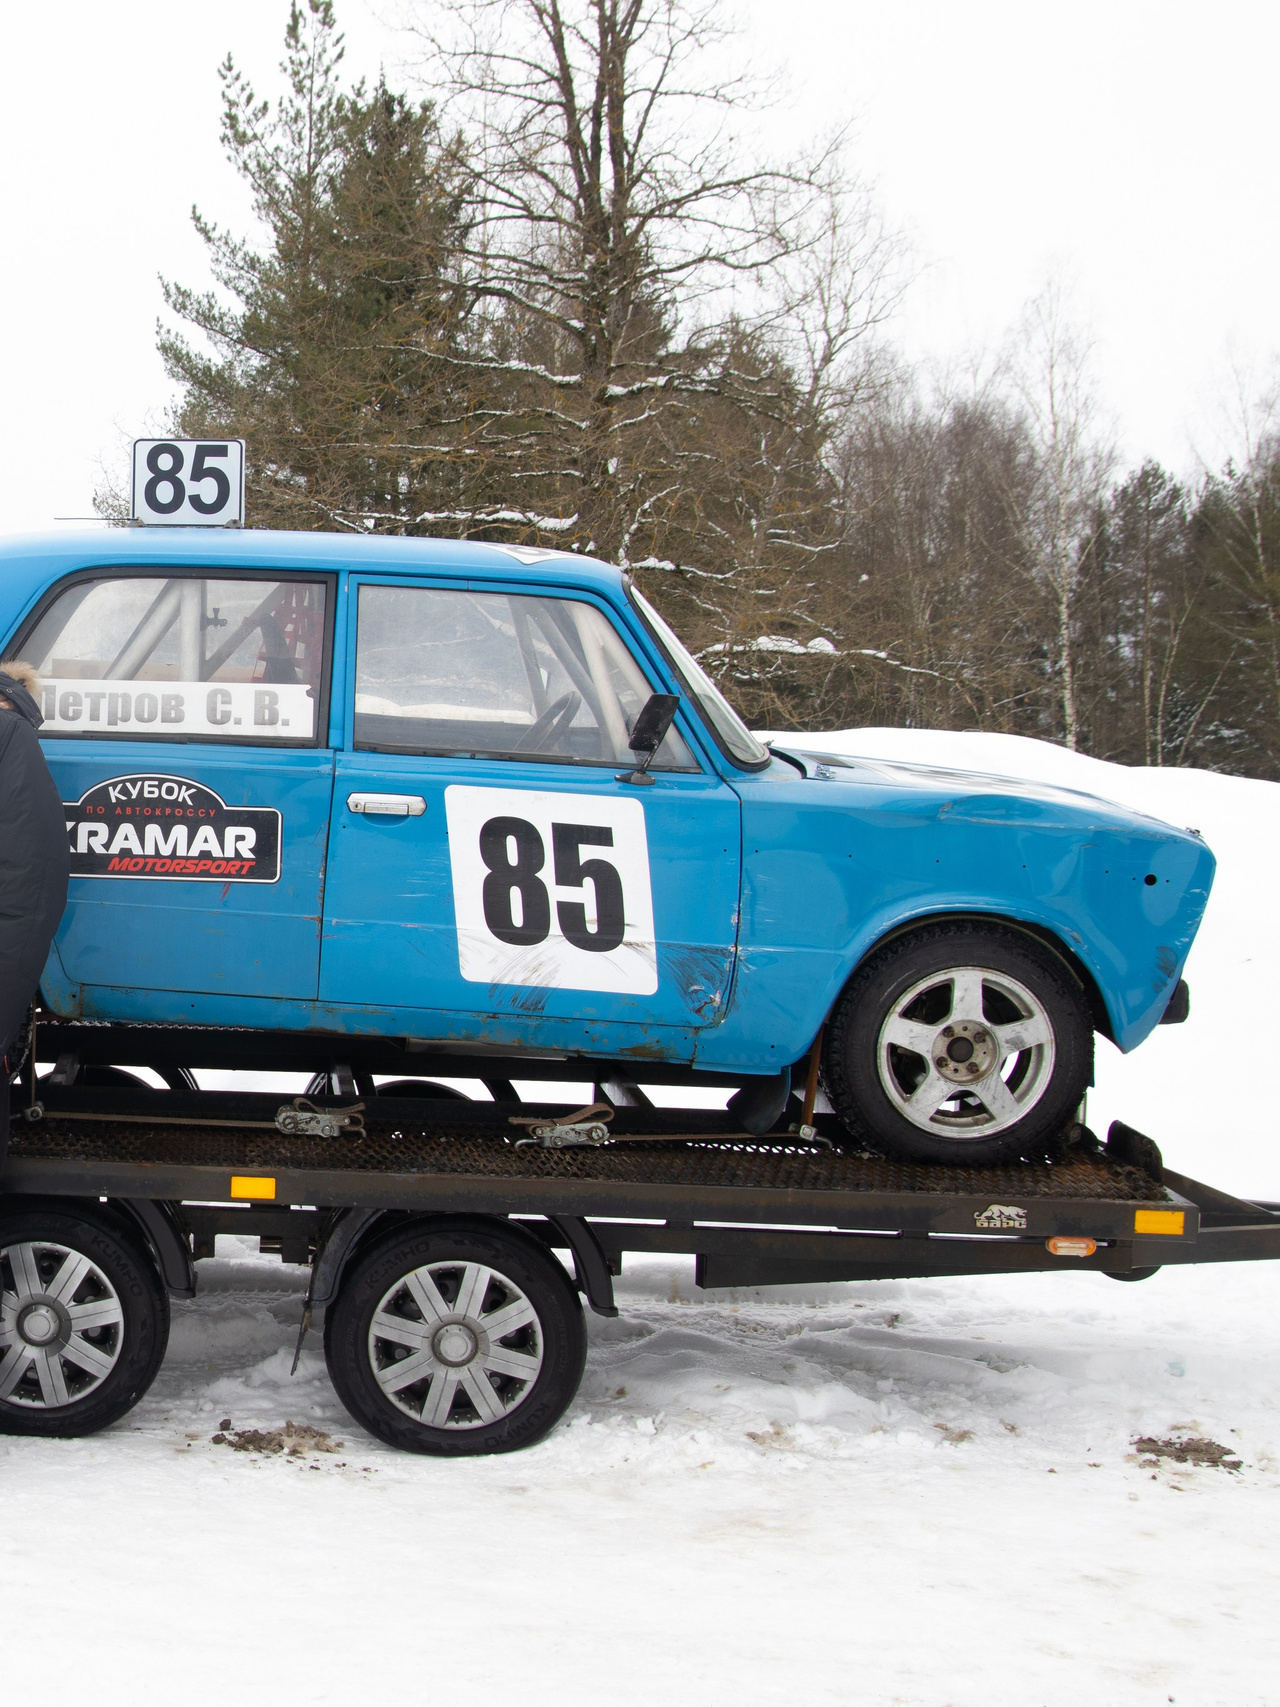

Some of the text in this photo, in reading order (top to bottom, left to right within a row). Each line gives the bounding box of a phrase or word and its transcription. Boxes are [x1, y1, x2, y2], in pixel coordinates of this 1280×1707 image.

[144, 443, 230, 515] 85
[206, 688, 242, 726] С.
[253, 689, 290, 727] В.
[86, 805, 217, 818] ПО АВТОКРОССУ
[108, 780, 197, 806] КУБОК
[107, 857, 256, 875] MOTORSPORT
[479, 815, 626, 953] 85
[90, 1235, 143, 1297] KUMHO
[366, 1241, 430, 1290] KUMHO
[483, 1401, 551, 1449] KUMHO
